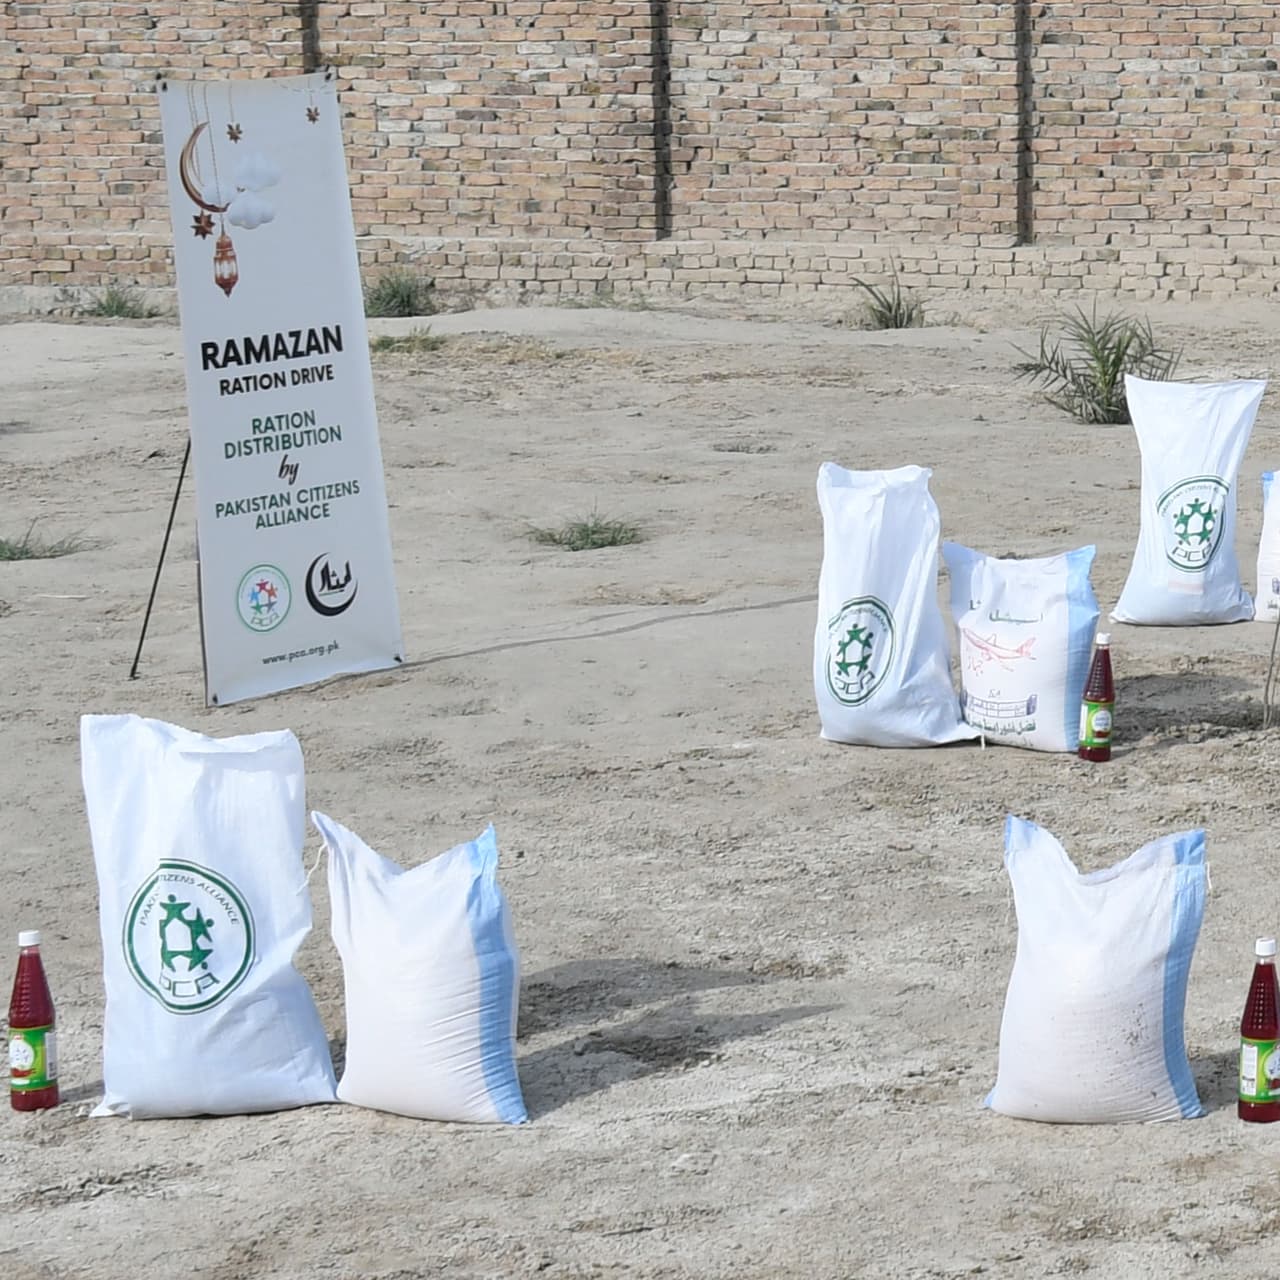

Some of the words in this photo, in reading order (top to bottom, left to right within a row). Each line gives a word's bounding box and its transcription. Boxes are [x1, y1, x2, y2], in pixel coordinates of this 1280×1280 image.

[201, 325, 343, 370] RAMAZAN
[219, 371, 287, 396] RATION
[291, 364, 335, 386] DRIVE
[251, 409, 316, 435] RATION
[224, 425, 342, 459] DISTRIBUTION
[278, 454, 299, 486] by
[215, 492, 291, 518] PAKISTAN
[296, 480, 360, 504] CITIZENS
[255, 503, 330, 530] ALLIANCE
[1172, 542, 1212, 562] PCA
[262, 640, 339, 664] www.pca.org.pk
[197, 882, 240, 926] ALLIANCE
